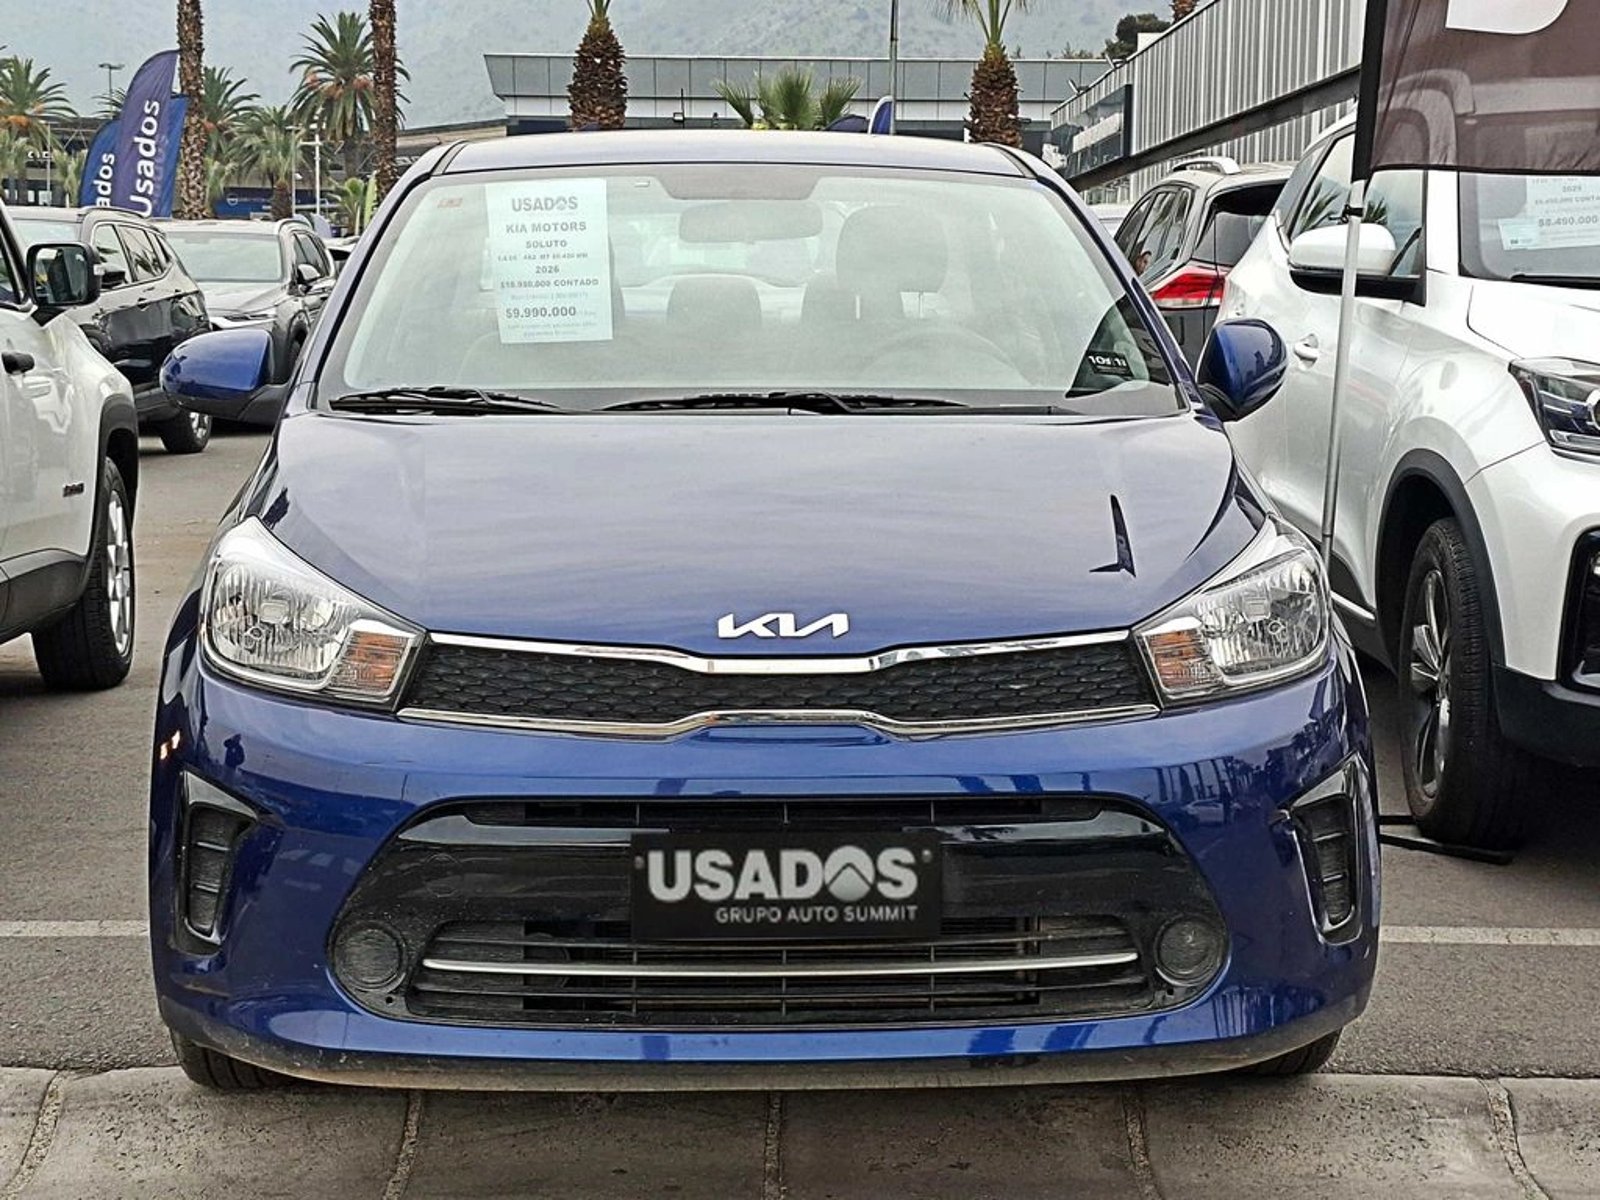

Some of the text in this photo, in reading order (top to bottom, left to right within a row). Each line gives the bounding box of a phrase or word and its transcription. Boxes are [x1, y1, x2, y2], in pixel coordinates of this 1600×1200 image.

[129, 100, 160, 217] Usados
[93, 153, 115, 207] ados
[511, 196, 579, 212] USADOS
[506, 221, 587, 234] KIA MOTORS
[525, 239, 568, 249] SOLUTO
[553, 278, 599, 287] CONTADO
[505, 306, 577, 319] $9.990.000
[648, 845, 918, 902] USADOS
[715, 905, 918, 924] GRUPO AUTO SUMMIT
